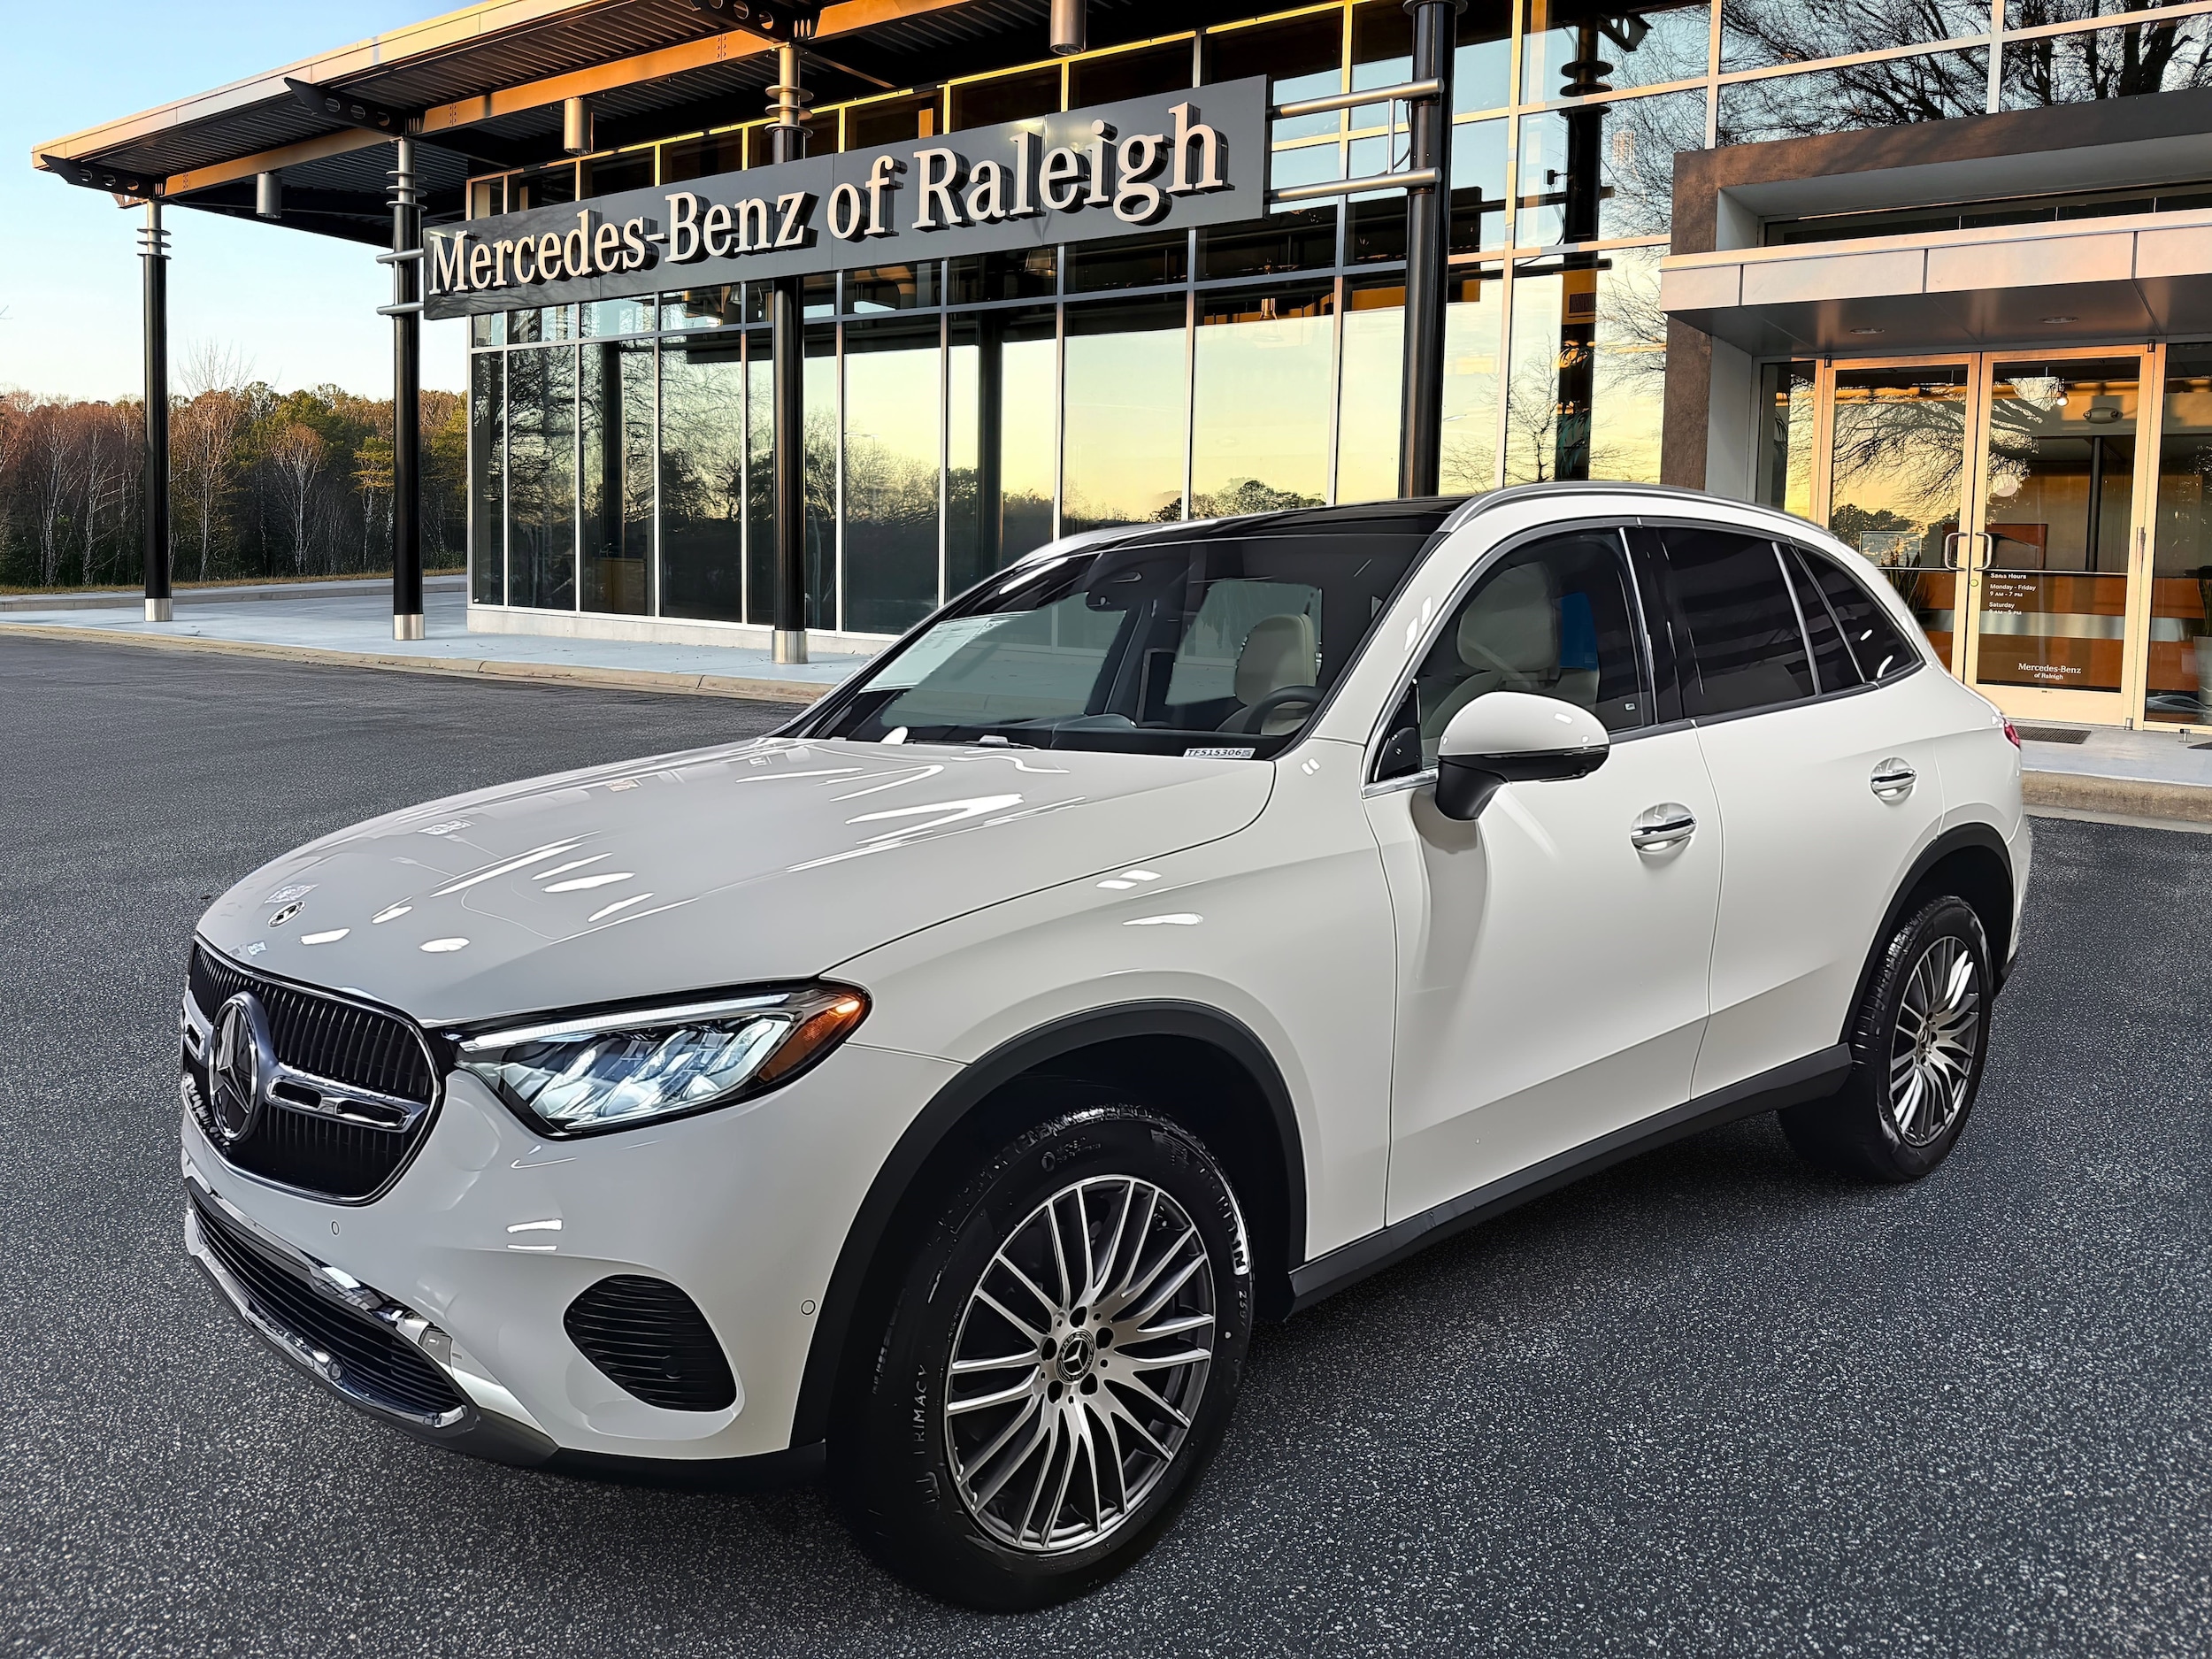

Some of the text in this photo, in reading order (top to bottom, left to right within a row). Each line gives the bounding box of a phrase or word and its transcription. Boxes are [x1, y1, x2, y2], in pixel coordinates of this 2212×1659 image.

[429, 102, 1224, 295] Mercedes-Benz of Raleigh
[2018, 663, 2082, 674] Mercedes-Benz
